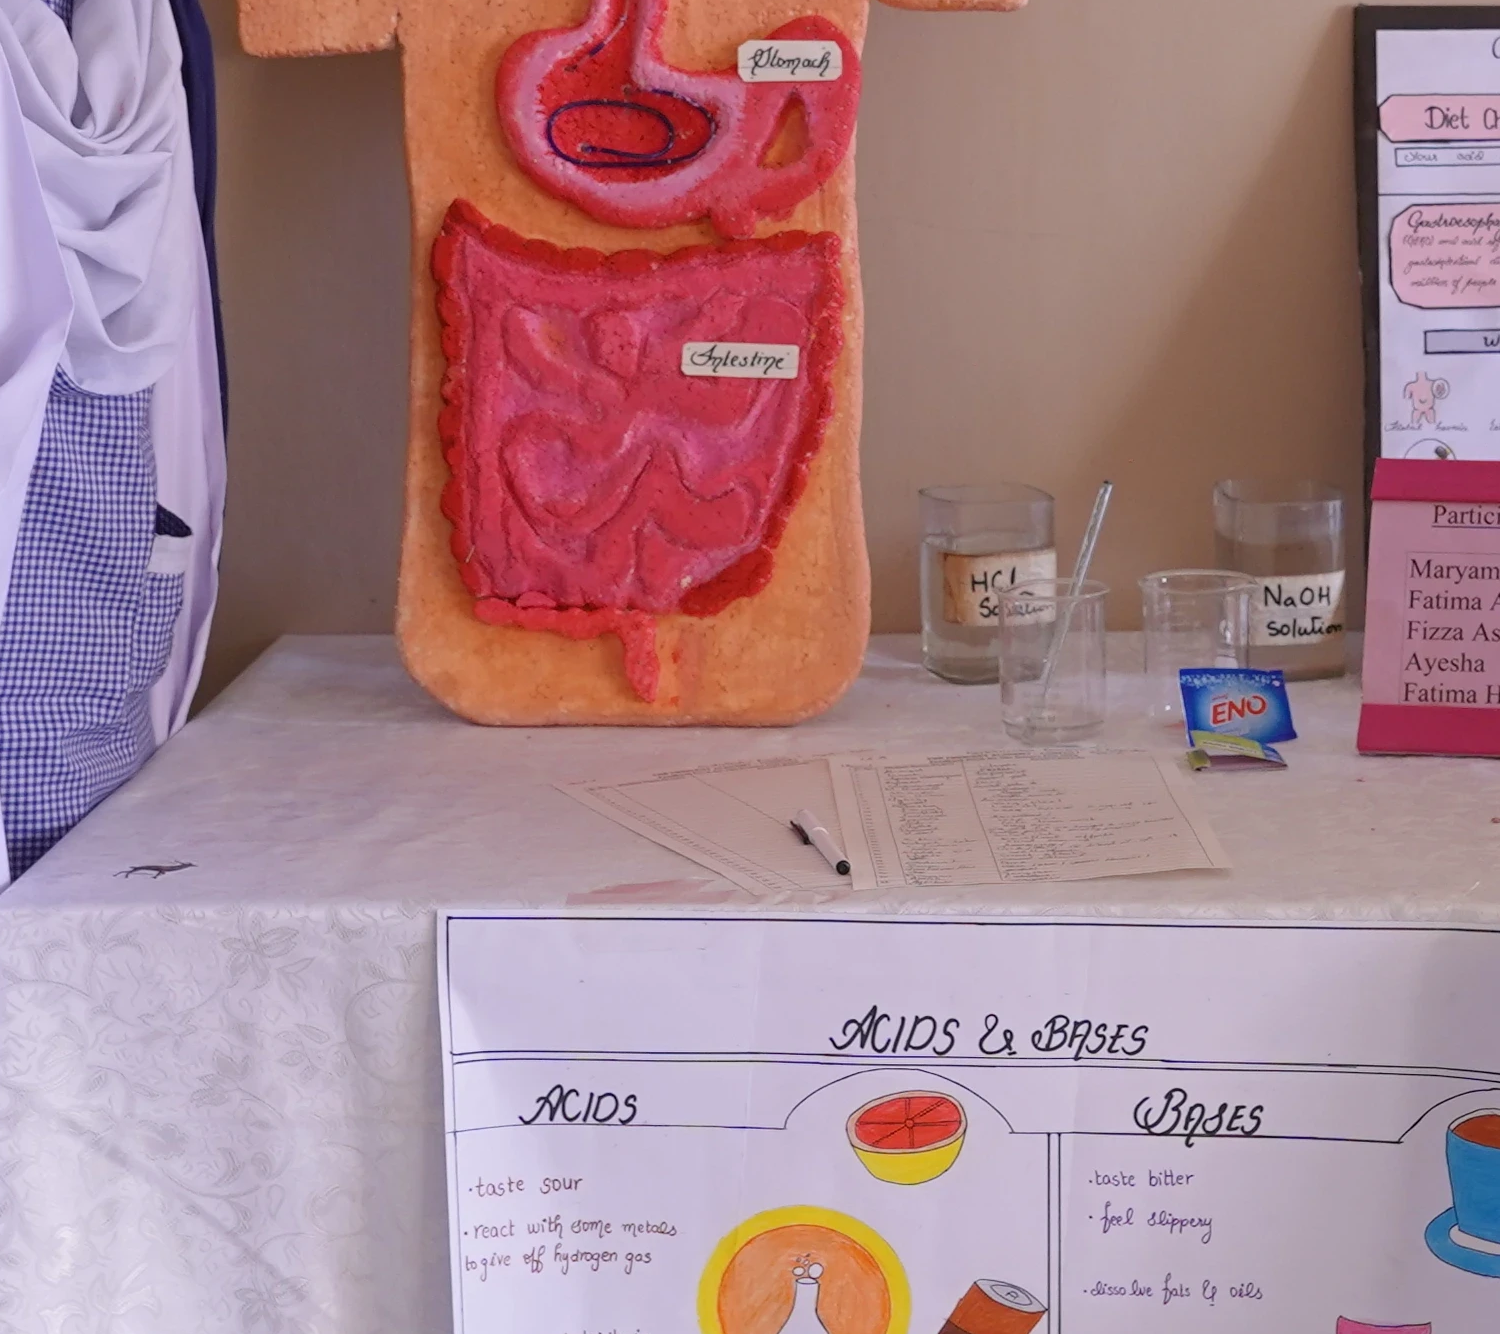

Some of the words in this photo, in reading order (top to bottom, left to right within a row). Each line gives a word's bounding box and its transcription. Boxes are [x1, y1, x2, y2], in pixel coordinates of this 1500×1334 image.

[748, 48, 833, 80] Stomach
[1424, 105, 1471, 130] Diet
[689, 344, 786, 376] Intestine
[1409, 558, 1500, 585] Maryam
[1263, 584, 1331, 607] NaOH
[1407, 589, 1483, 612] Fatima
[1406, 619, 1464, 642] Fizza
[1404, 651, 1486, 677] Ayesha
[1402, 681, 1477, 705] Fatima
[1210, 695, 1268, 727] ENO
[828, 1004, 961, 1057] ACIDS
[977, 1013, 1018, 1057] &
[1030, 1013, 1150, 1062] BASES
[517, 1083, 638, 1126] ACIDS
[1133, 1086, 1265, 1149] BASES
[474, 1175, 526, 1198] taste
[539, 1175, 584, 1196] sour
[1094, 1168, 1137, 1188] taste
[1147, 1169, 1195, 1188] bitter
[472, 1218, 516, 1240] react
[526, 1213, 564, 1240] with
[569, 1218, 614, 1239] some
[620, 1218, 679, 1239] metals
[1099, 1199, 1135, 1235] feel
[1146, 1209, 1214, 1245] slippery
[464, 1255, 478, 1272] to
[479, 1252, 512, 1283] give
[522, 1244, 547, 1274] off
[553, 1242, 619, 1276] hydrogen
[623, 1249, 653, 1276] gas
[1160, 1271, 1192, 1306] fats
[1228, 1281, 1264, 1301] oils
